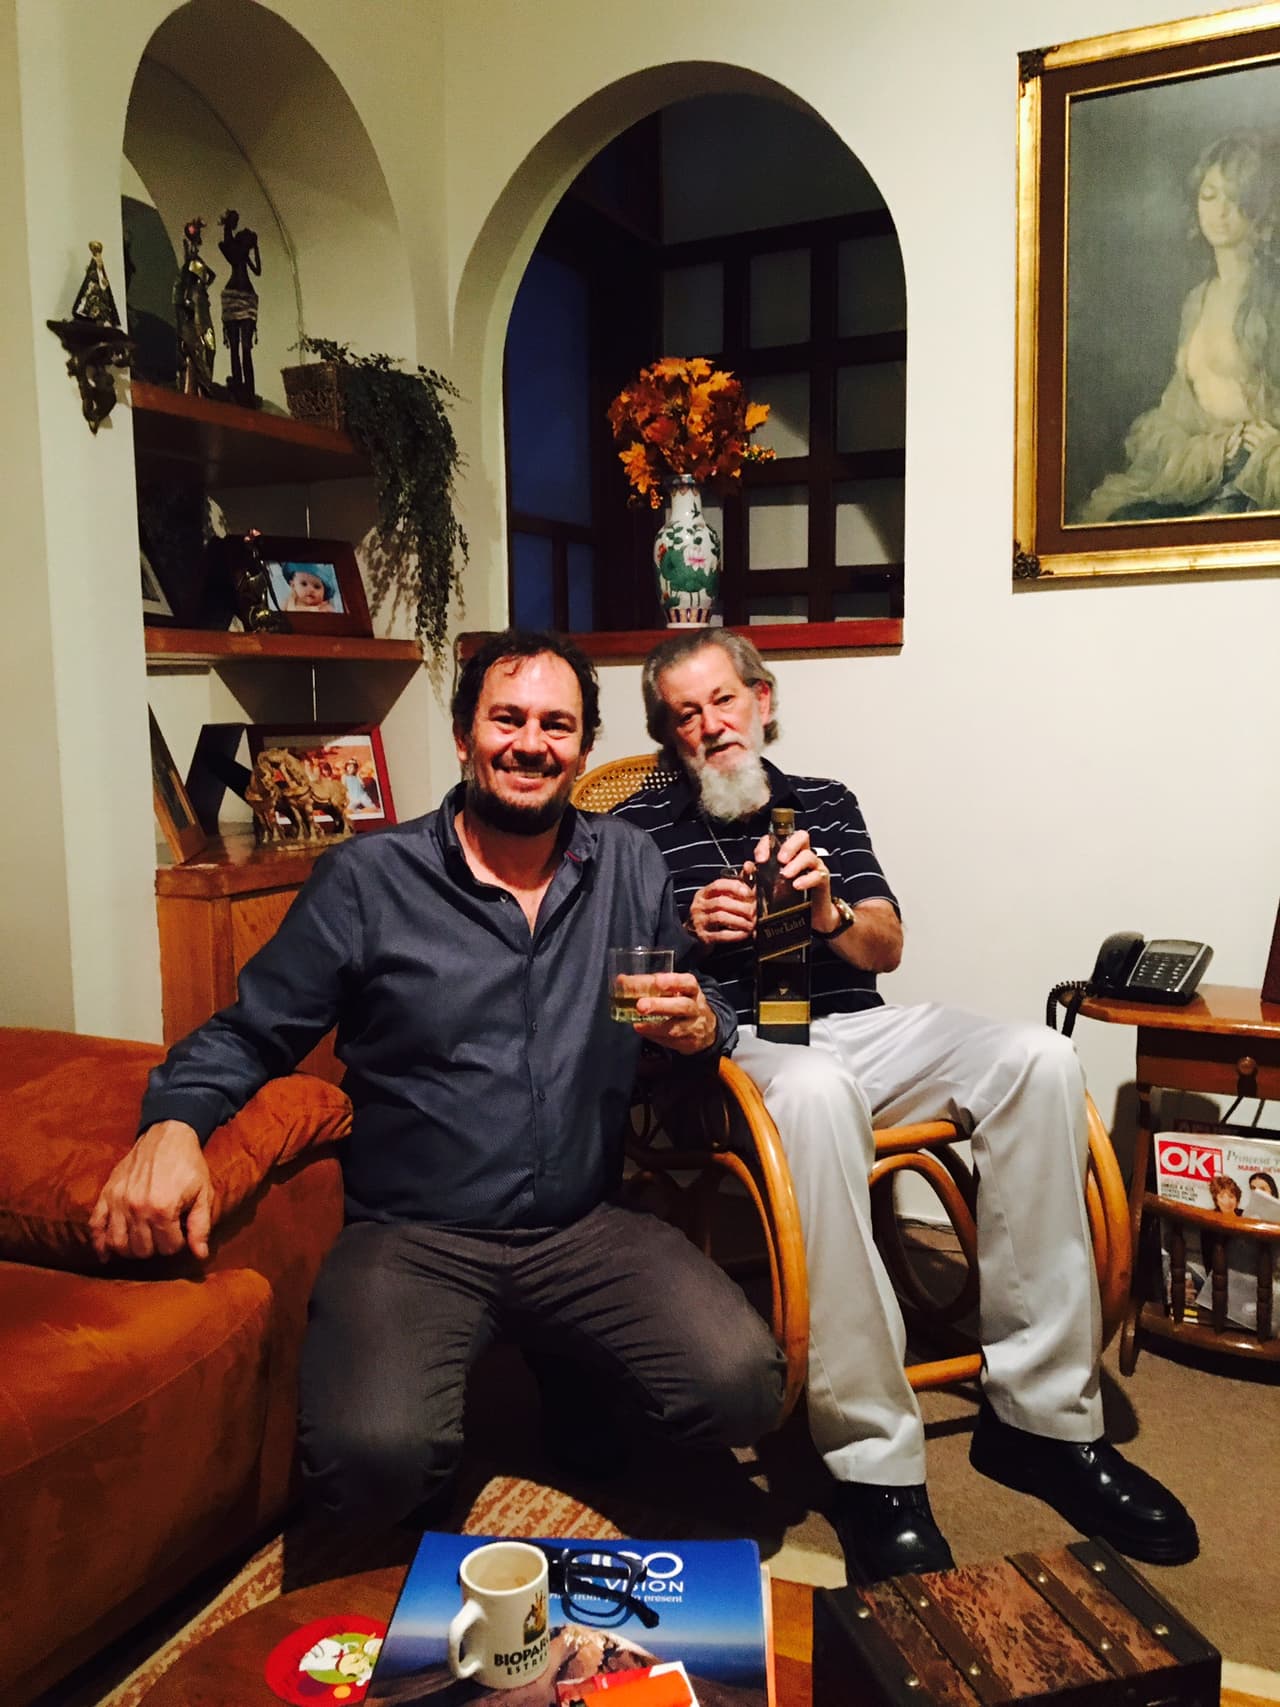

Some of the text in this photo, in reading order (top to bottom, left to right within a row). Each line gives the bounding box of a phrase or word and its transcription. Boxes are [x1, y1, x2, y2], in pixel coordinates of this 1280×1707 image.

[1160, 1146, 1222, 1178] OK!
[644, 1594, 683, 1603] present
[494, 1637, 550, 1667] BIOPAR
